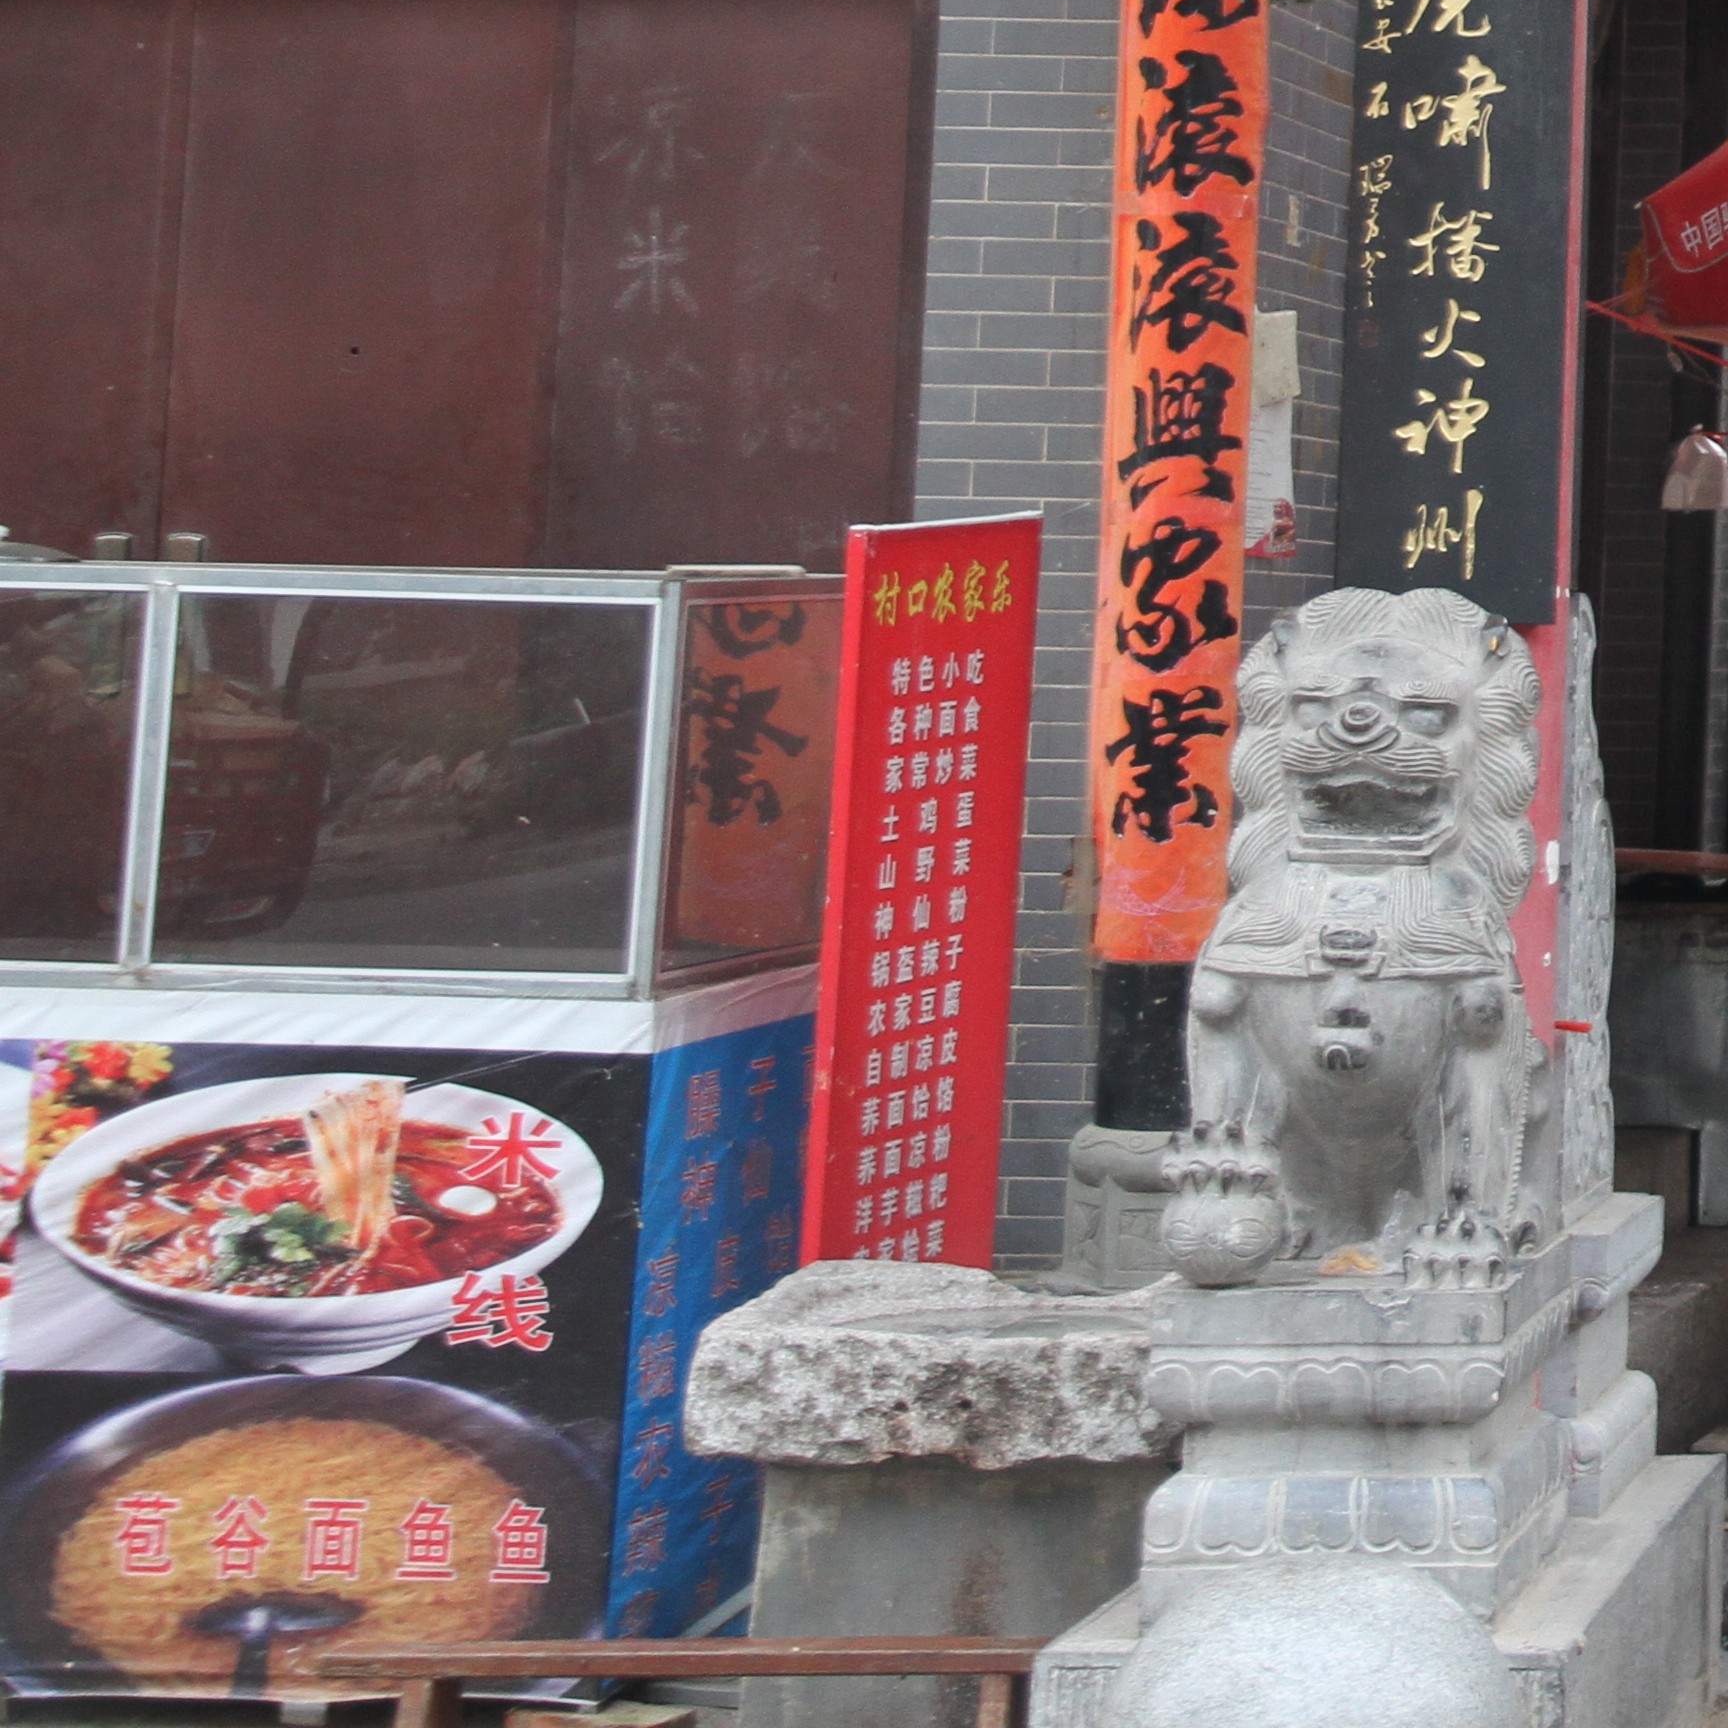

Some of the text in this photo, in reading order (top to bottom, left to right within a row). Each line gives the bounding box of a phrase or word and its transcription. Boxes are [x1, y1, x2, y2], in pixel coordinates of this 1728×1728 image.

[873, 559, 1014, 627] 村口农家乐
[890, 649, 986, 696] 特色小吃
[888, 696, 982, 746] 各种面食
[884, 743, 979, 795] 家常炒菜
[880, 790, 975, 843] 土鸡蛋
[877, 838, 972, 891] 山野菜
[866, 980, 962, 1038] 农家豆腐
[864, 1026, 959, 1088] 自制凉皮
[444, 1110, 564, 1353] 米线
[113, 1491, 552, 1585] 苞谷面鱼鱼
